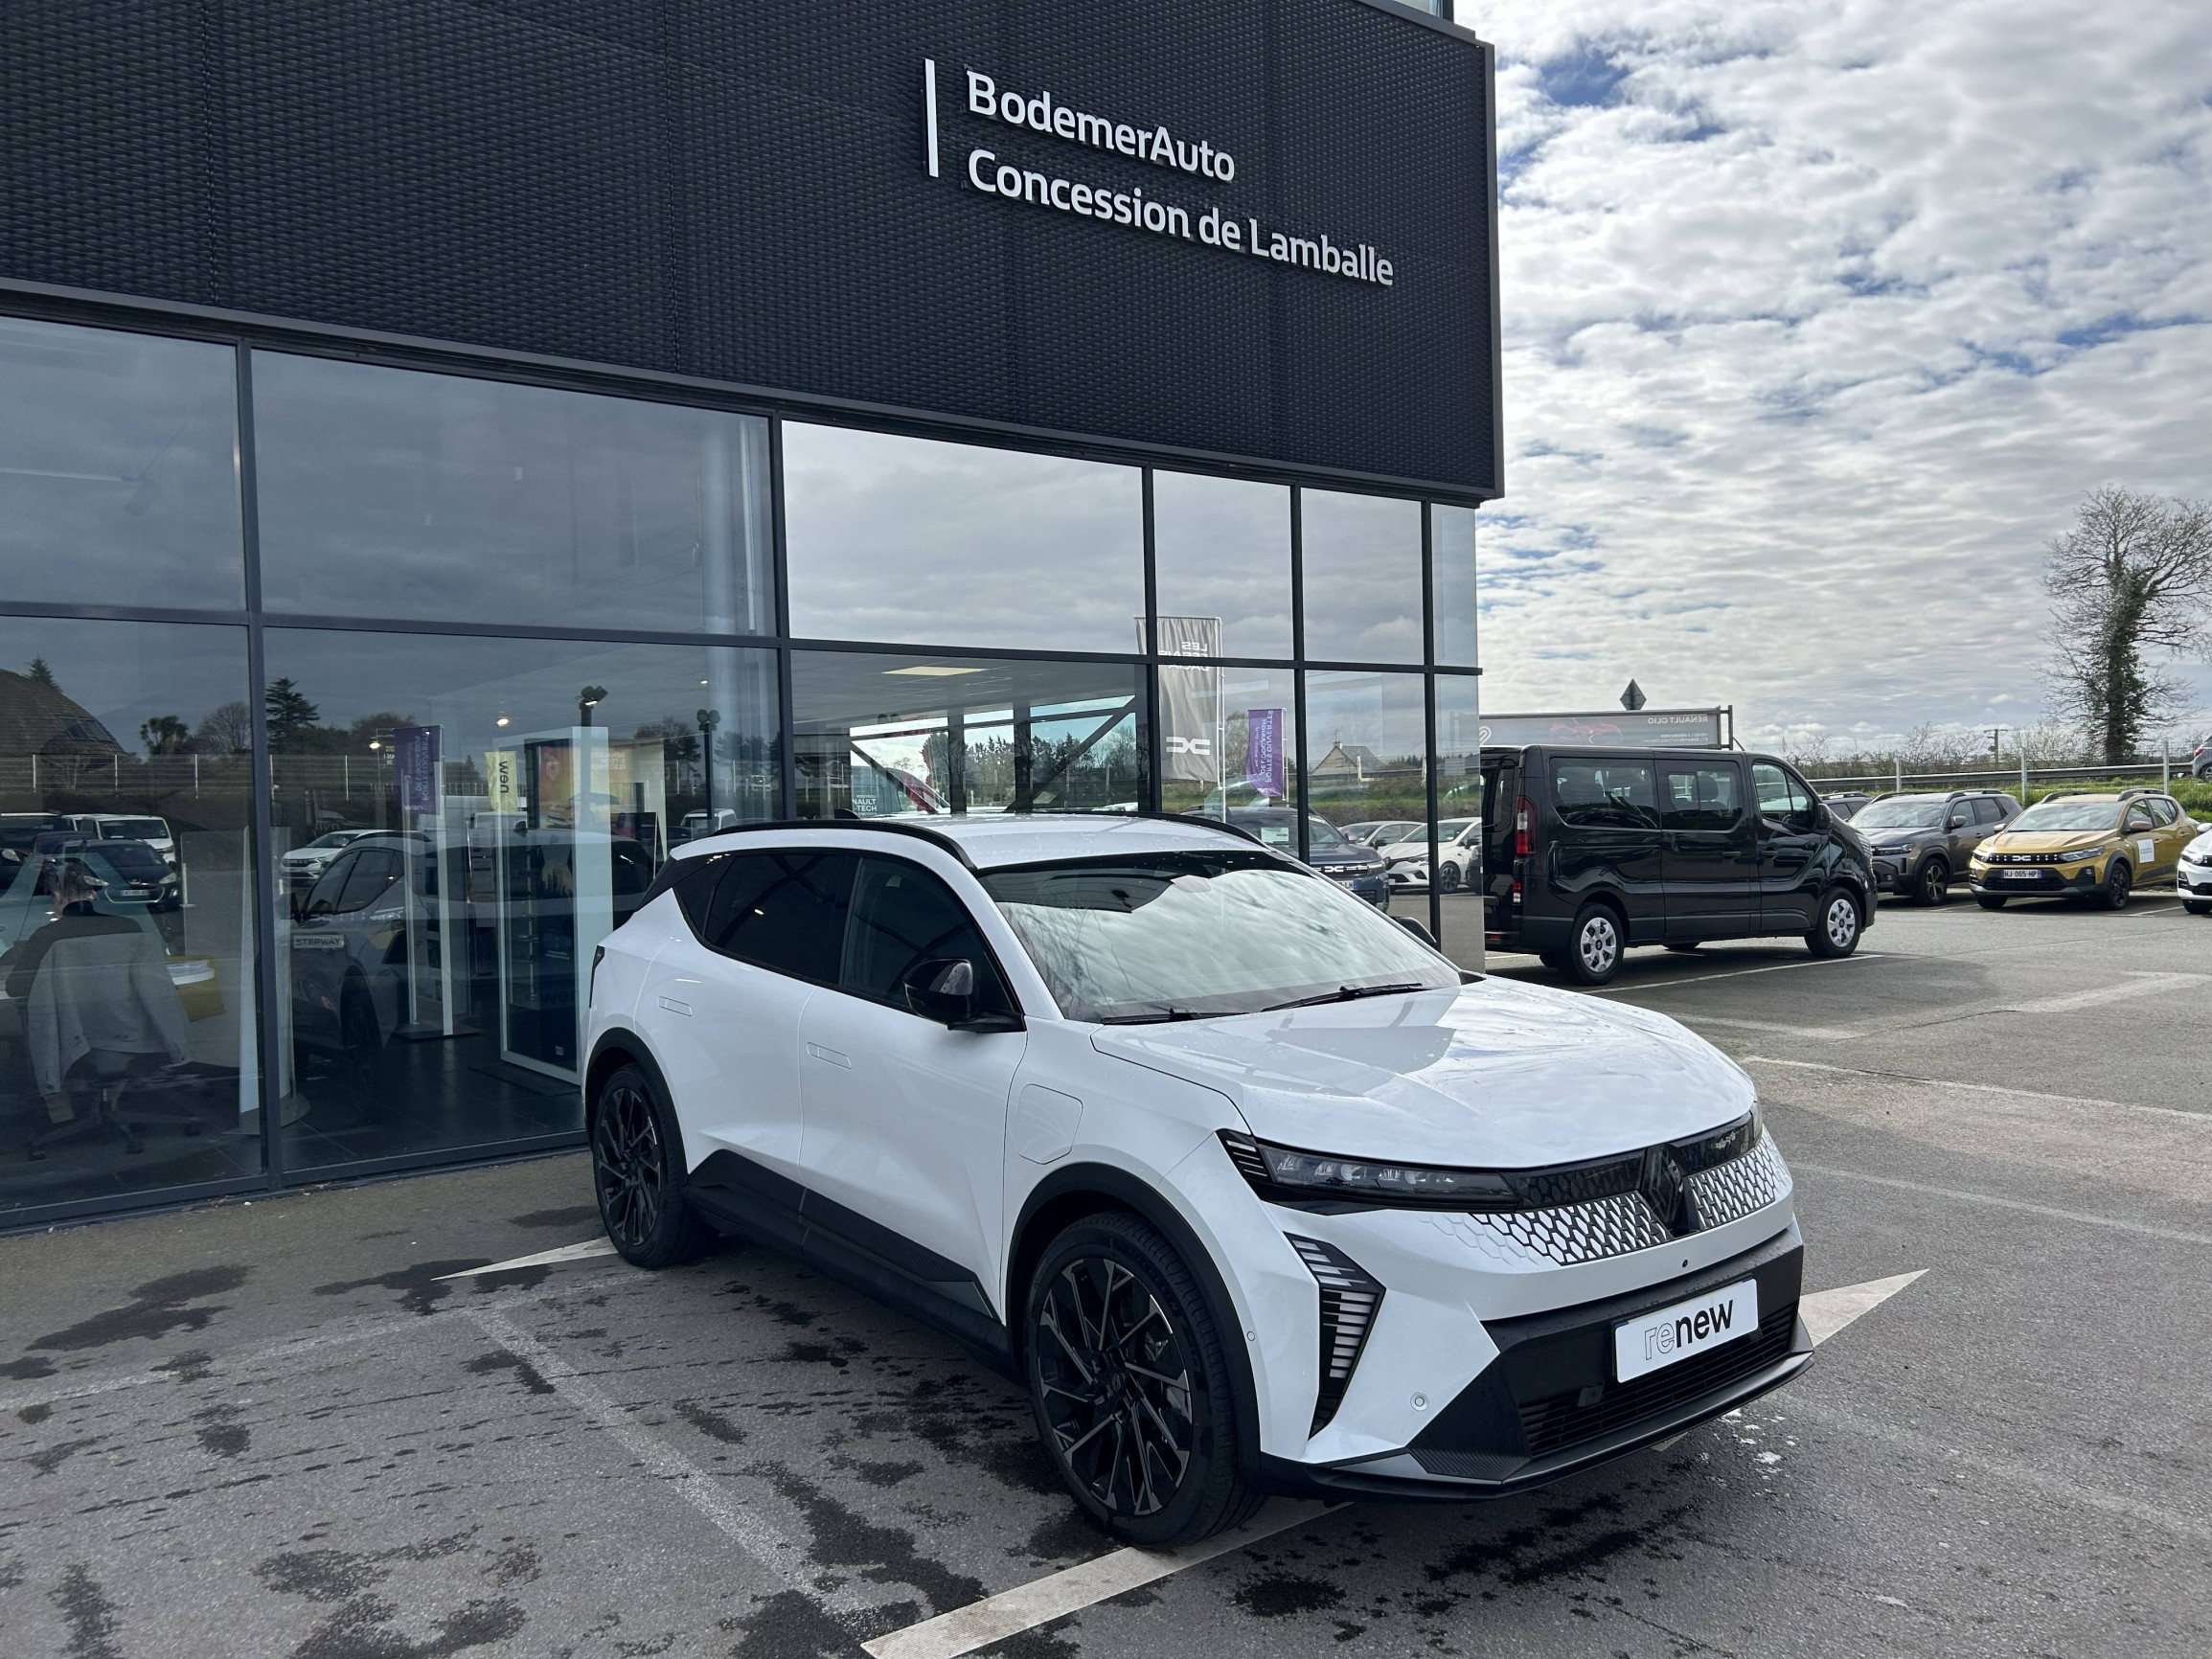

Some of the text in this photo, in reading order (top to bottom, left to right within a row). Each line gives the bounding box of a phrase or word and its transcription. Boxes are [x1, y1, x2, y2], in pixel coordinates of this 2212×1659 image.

[967, 70, 1236, 182] BodemerAuto
[968, 148, 1394, 285] Concession de Lamballe
[1644, 1299, 1734, 1361] renew
